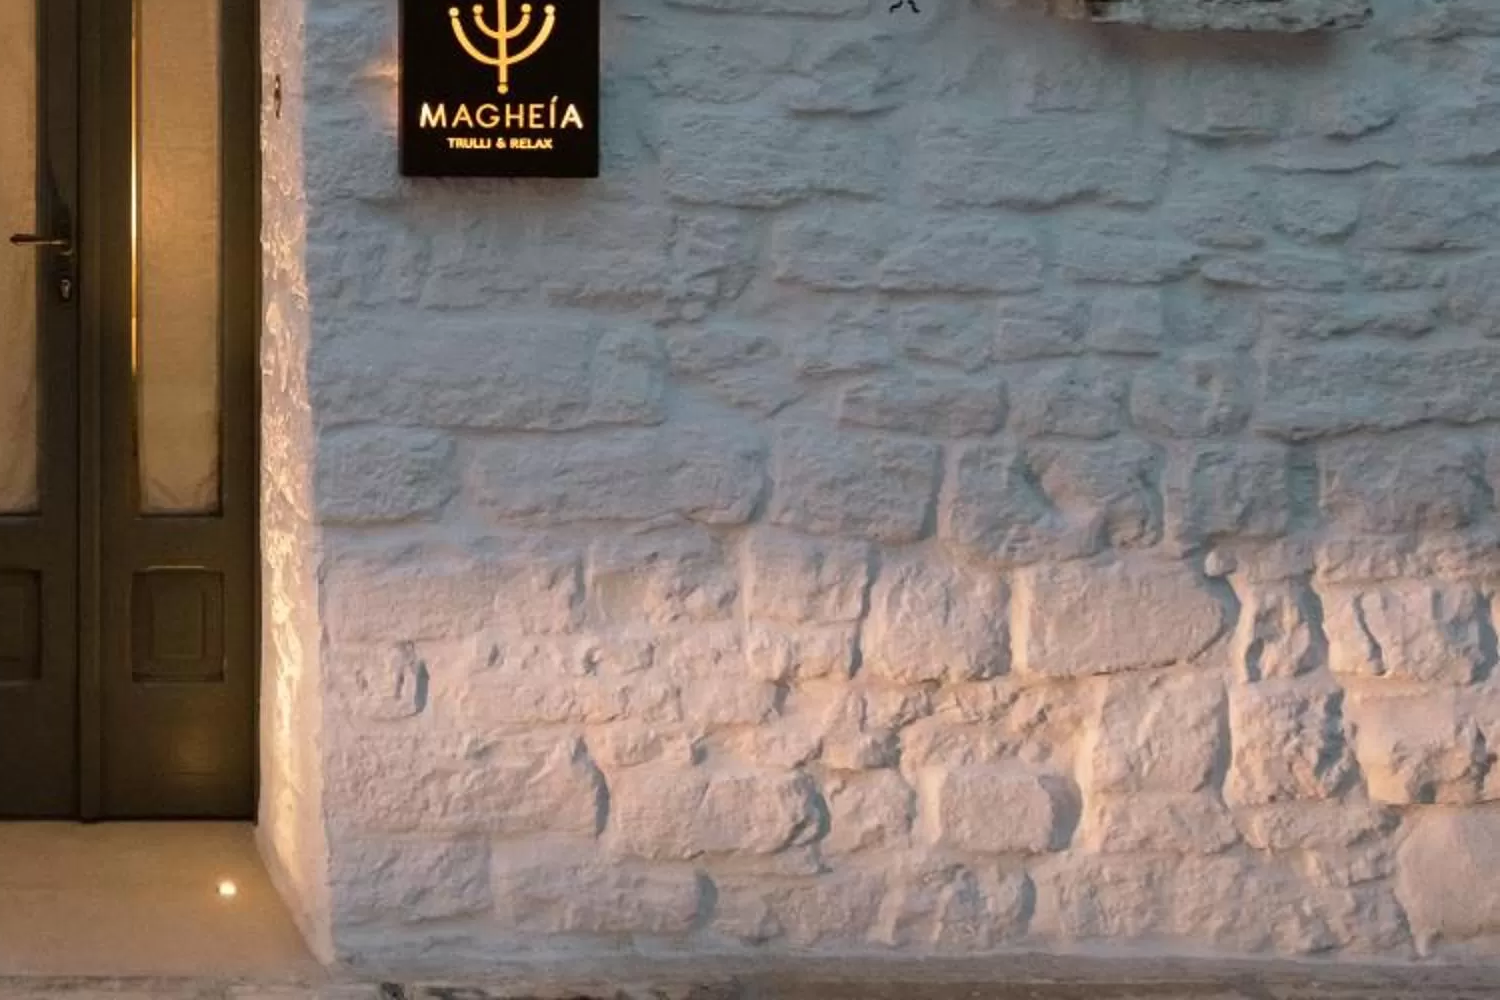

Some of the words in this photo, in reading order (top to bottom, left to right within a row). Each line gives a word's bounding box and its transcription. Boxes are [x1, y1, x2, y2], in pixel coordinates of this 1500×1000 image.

[419, 95, 583, 129] MAGHEÍA
[447, 137, 491, 149] TRULLI
[495, 137, 507, 149] &
[510, 137, 553, 149] RELAX
